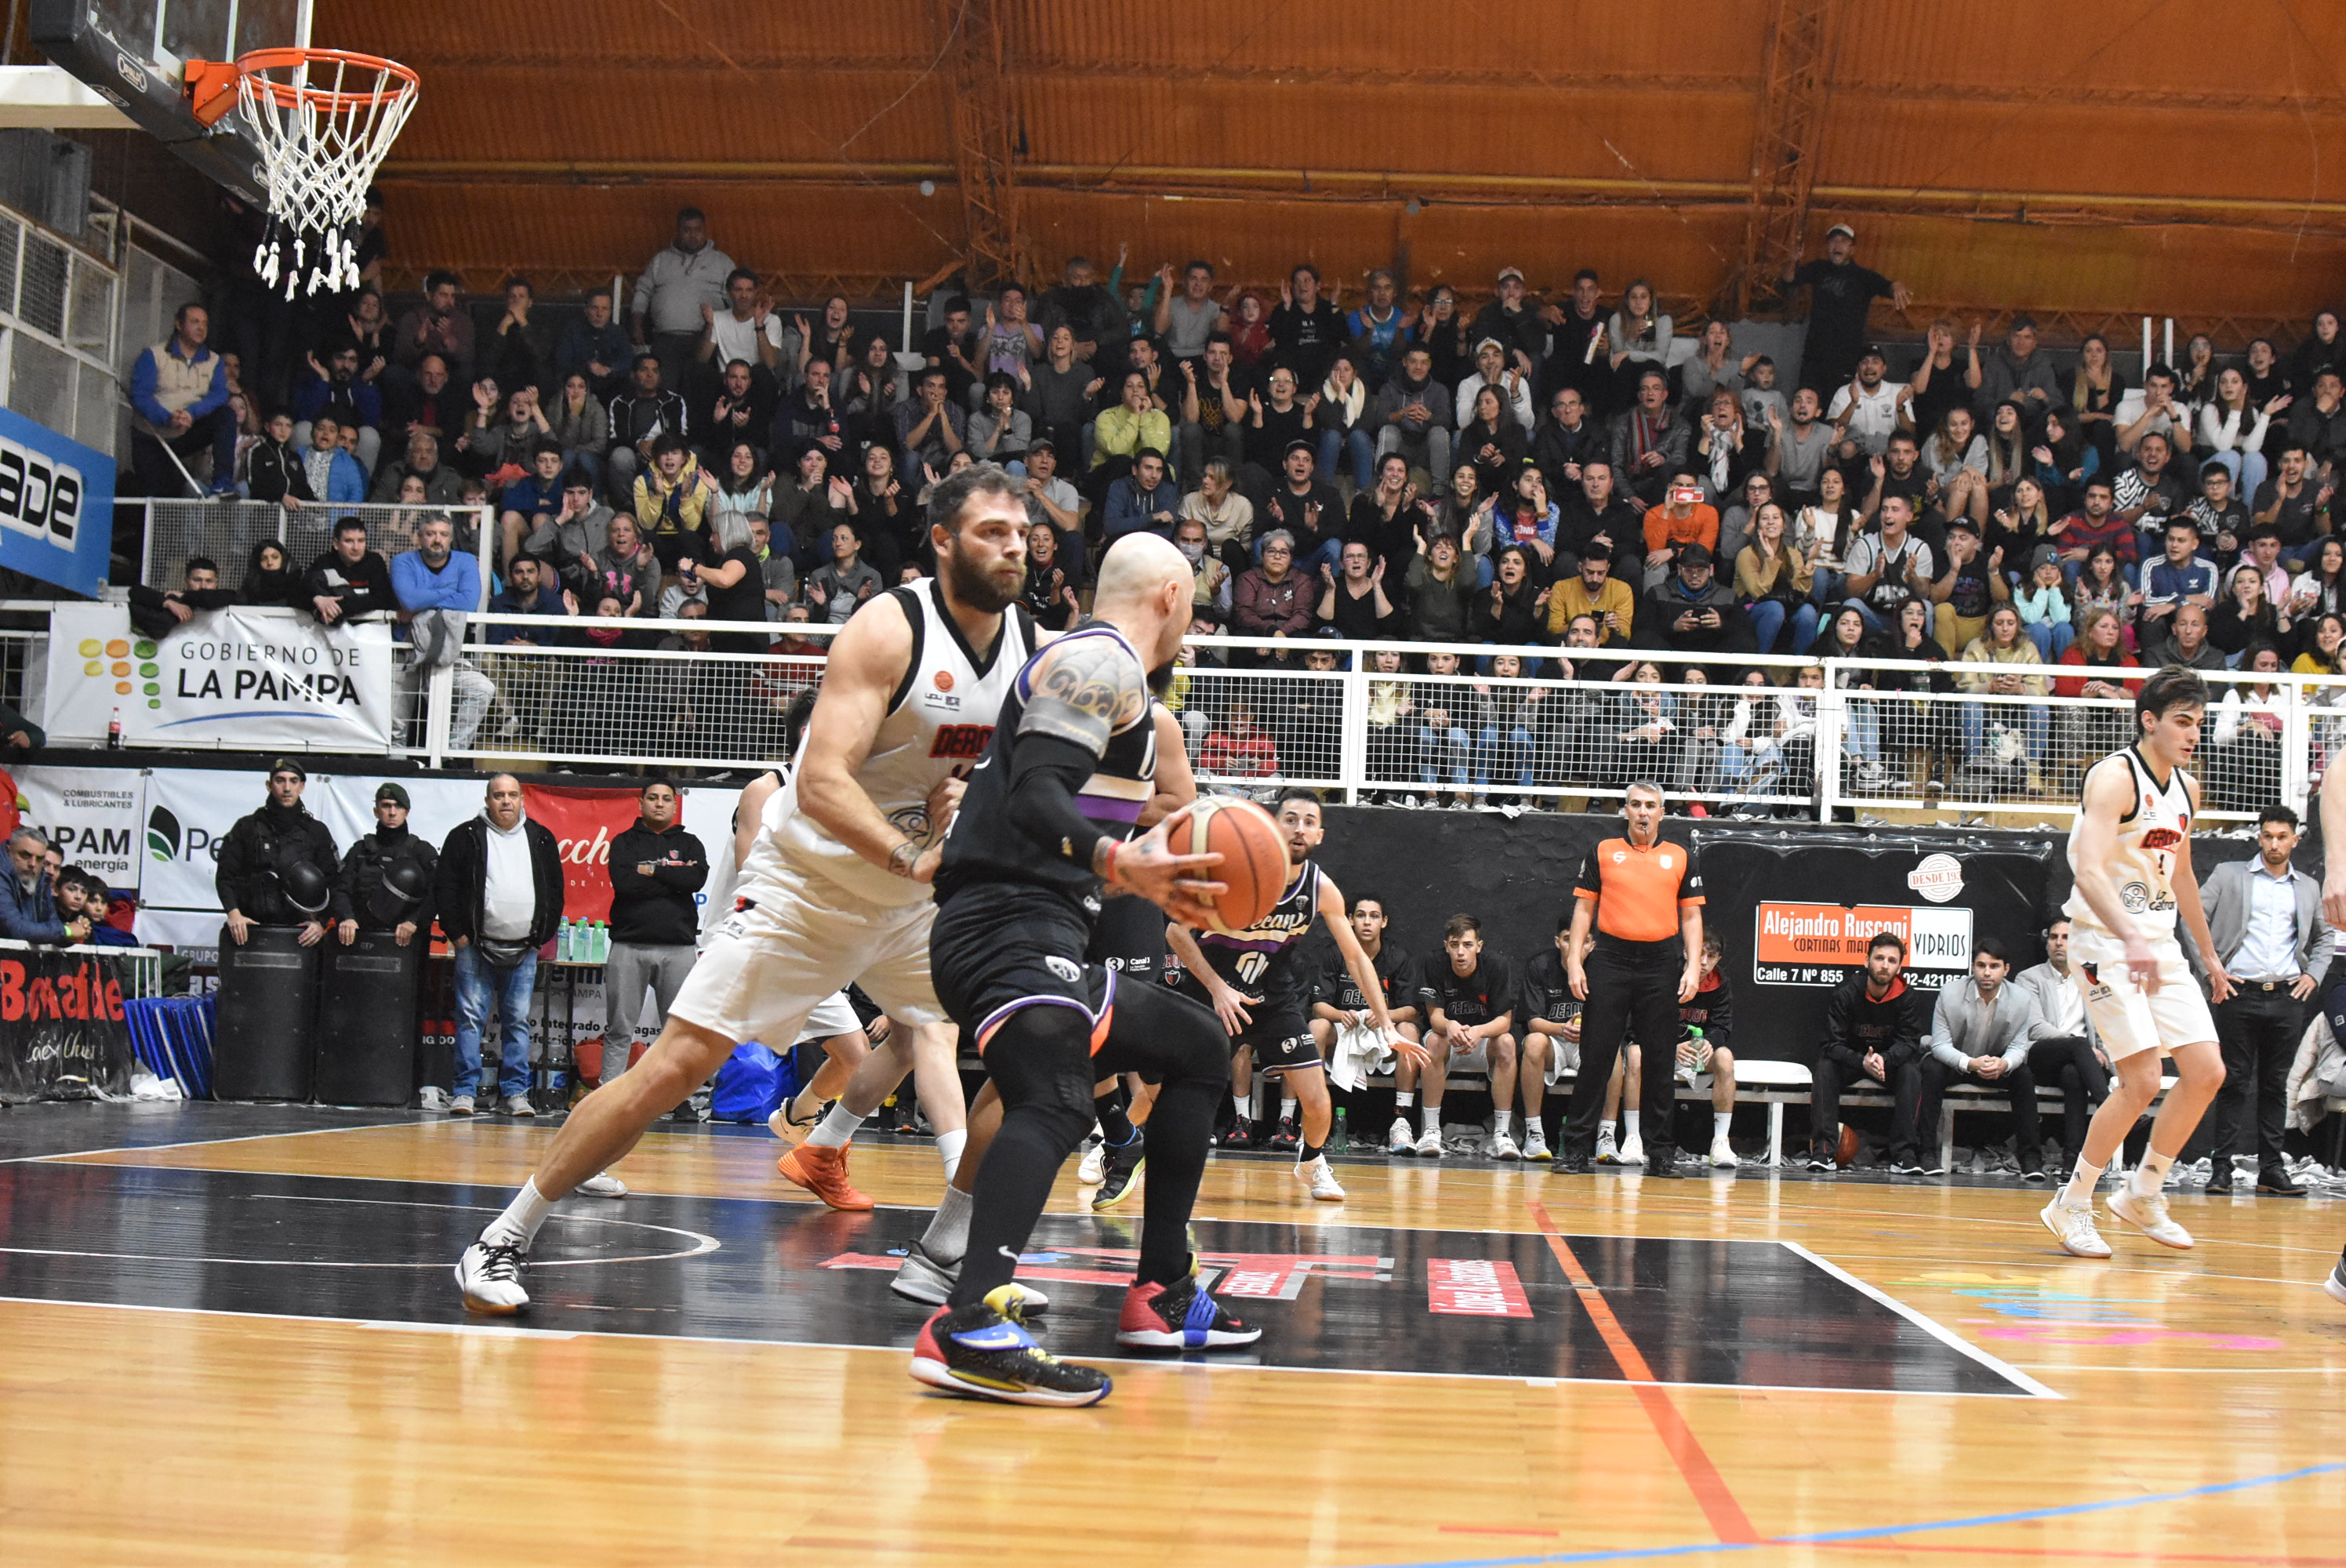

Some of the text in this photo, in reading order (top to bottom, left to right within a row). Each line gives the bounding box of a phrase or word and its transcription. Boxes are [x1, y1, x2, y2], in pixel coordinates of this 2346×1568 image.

[181, 641, 360, 666] GOBIERNO DE
[177, 668, 361, 706] LA PAMPA
[63, 789, 134, 799] COMBUSTIBLES
[71, 800, 133, 809] LUBRICANTES
[75, 858, 129, 873] energía
[1912, 872, 1945, 885] DESDE
[1764, 910, 1908, 941] Alejandro Rusconi
[1793, 938, 1841, 953] CORTINAS
[1913, 933, 1966, 956] VIDRIOS
[181, 949, 219, 964] GRUPO
[1757, 967, 1788, 981] Calle
[1791, 968, 1798, 981] 7
[1820, 970, 1843, 983] 855
